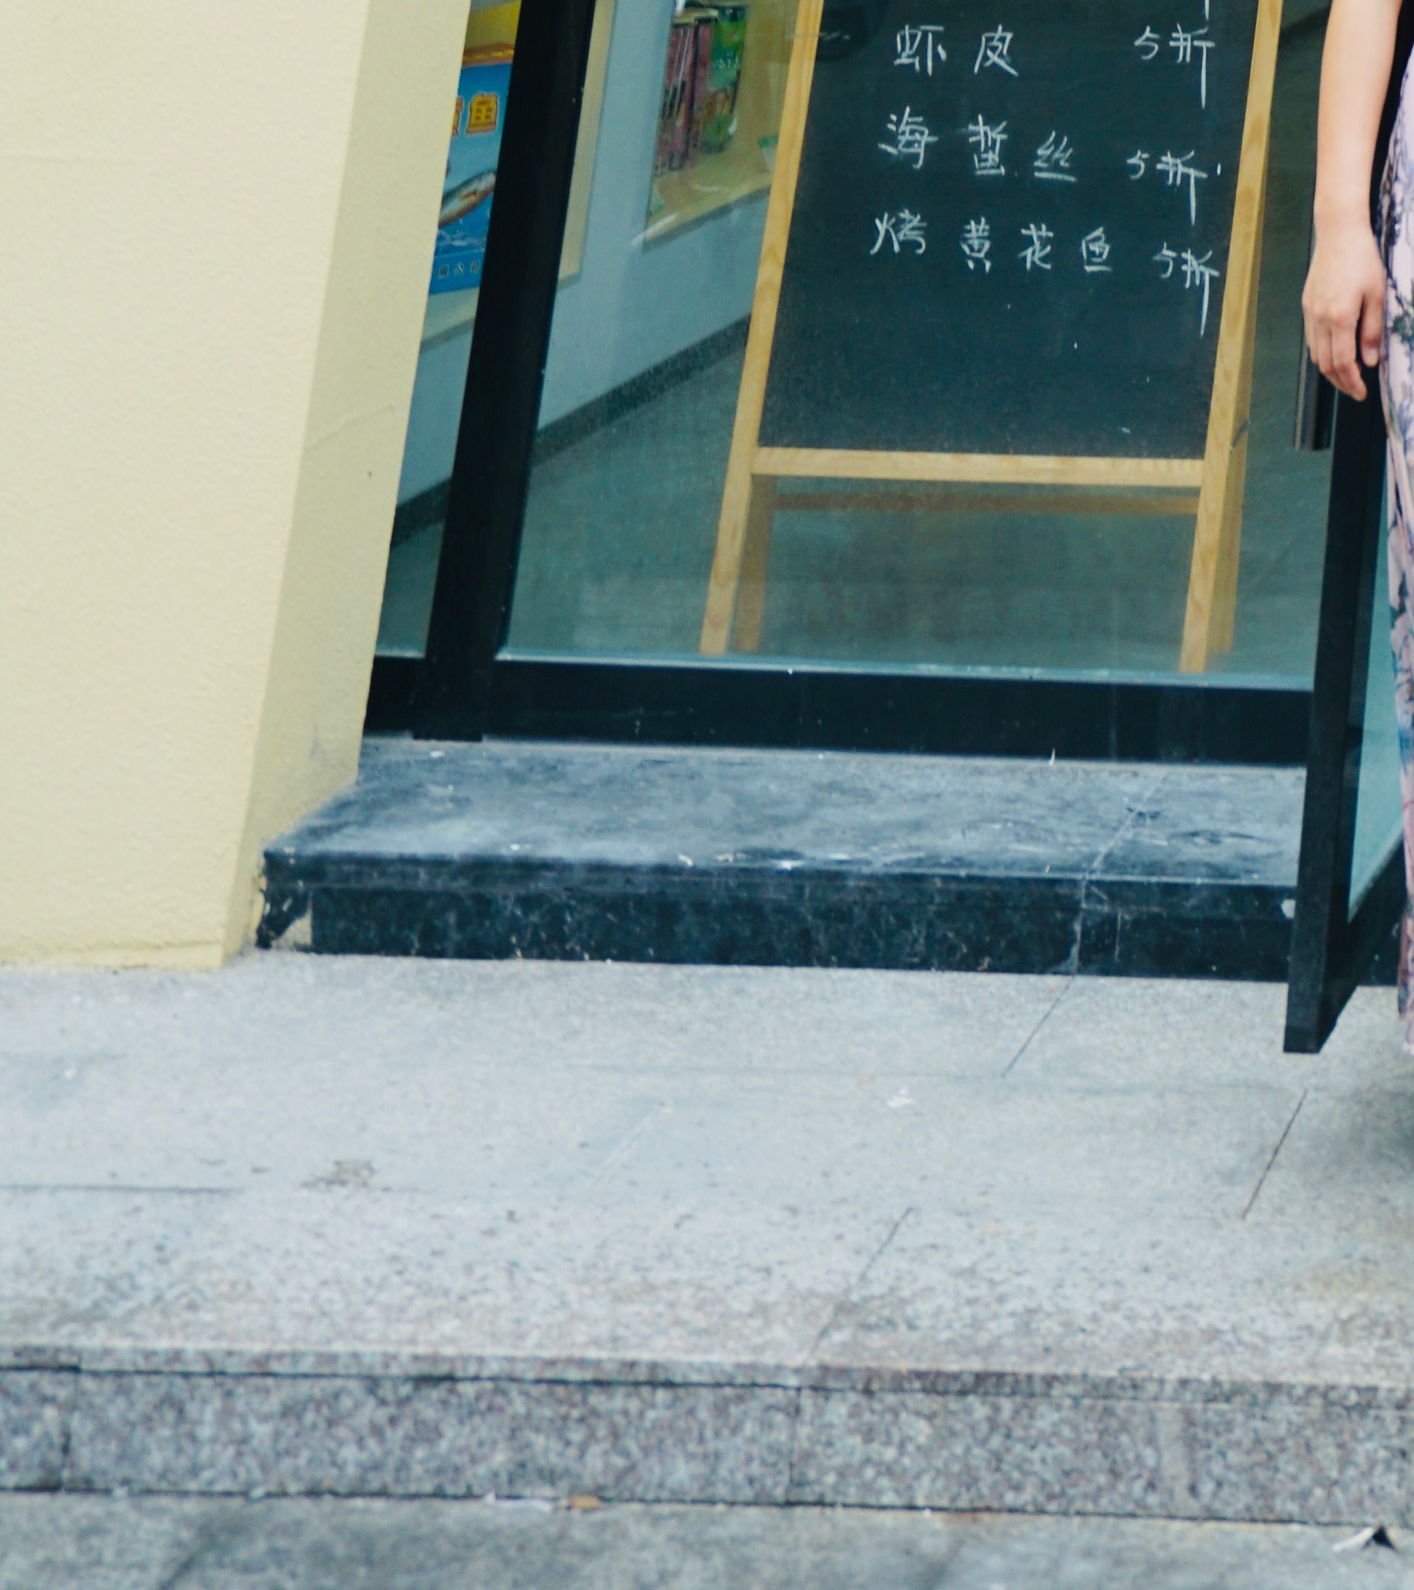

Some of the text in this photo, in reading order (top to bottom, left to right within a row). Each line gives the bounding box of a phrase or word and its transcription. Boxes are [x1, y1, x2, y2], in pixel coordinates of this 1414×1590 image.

[894, 23, 1216, 109] 虾皮 5折
[1126, 149, 1208, 226] 5折
[869, 208, 1221, 337] 烤黄花鱼 5折
